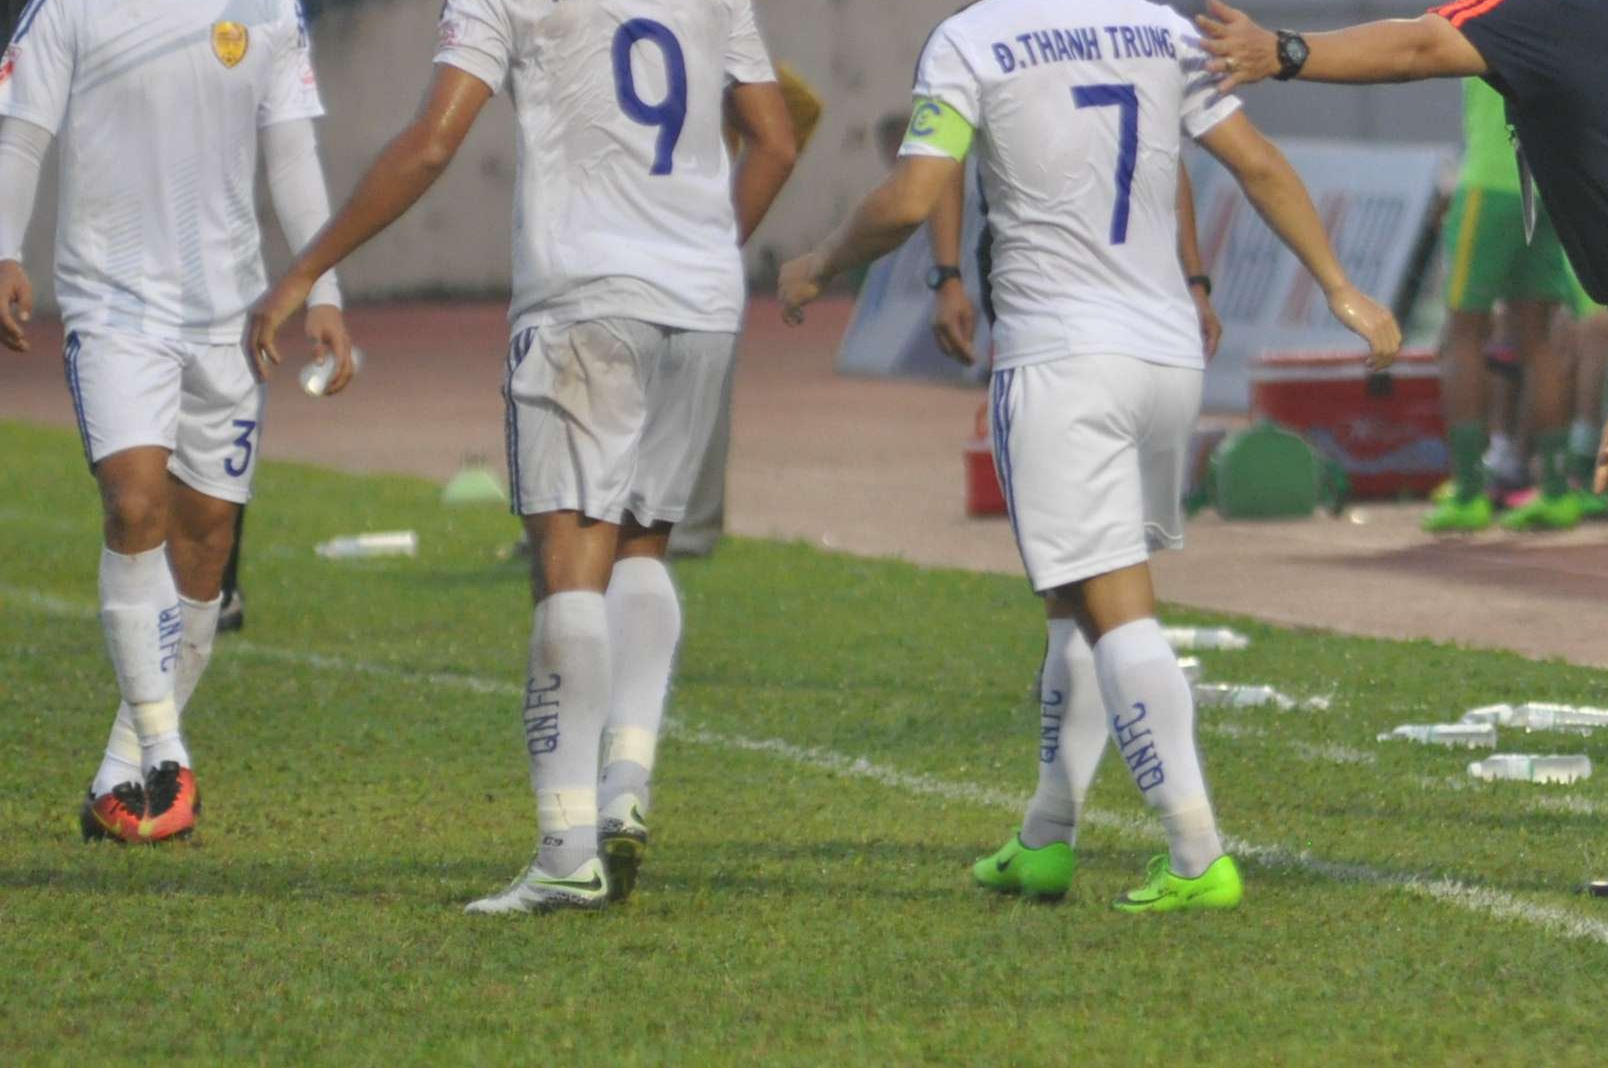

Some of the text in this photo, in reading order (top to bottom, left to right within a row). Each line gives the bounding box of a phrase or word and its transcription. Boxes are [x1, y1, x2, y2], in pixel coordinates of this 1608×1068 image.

[992, 25, 1178, 74] Đ.THANH TRUNG
[610, 17, 688, 176] 9
[910, 103, 941, 136] C
[1070, 83, 1139, 245] 7
[224, 419, 256, 477] 3
[524, 673, 561, 756] QNFC
[1113, 702, 1165, 793] QNFC
